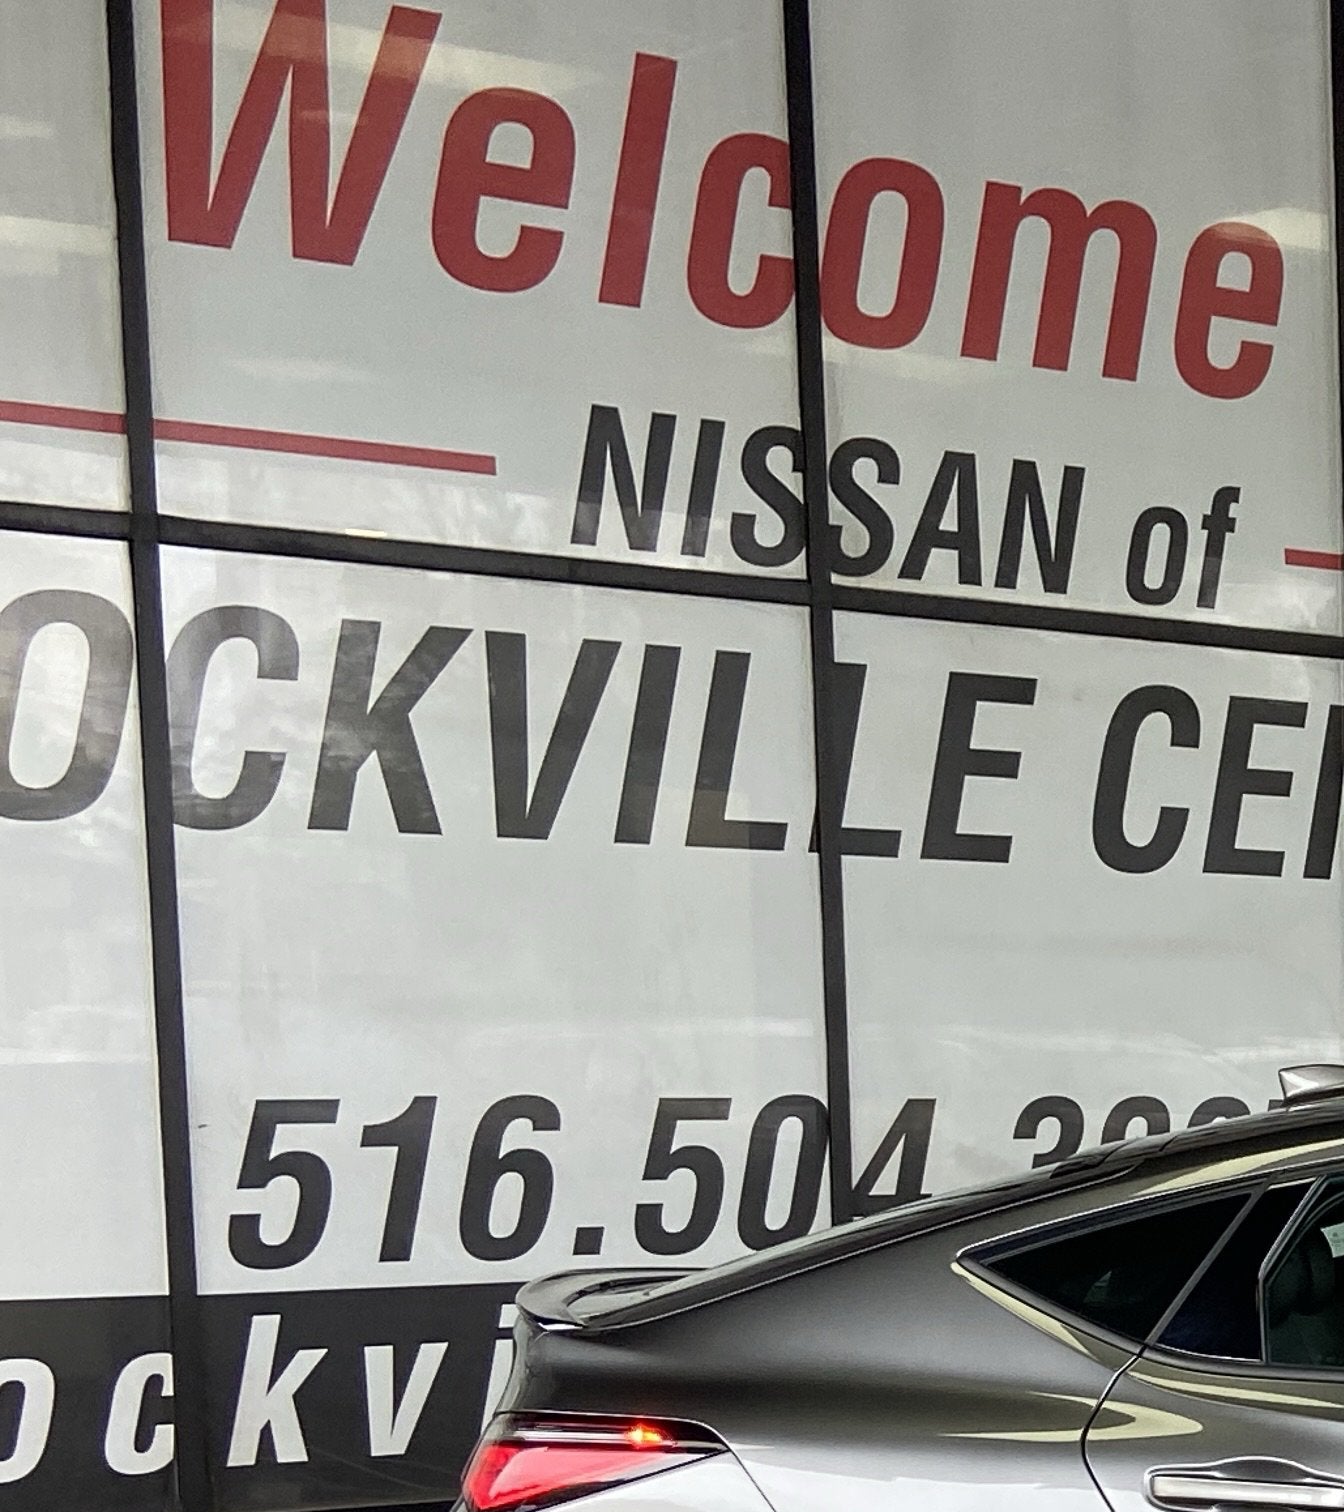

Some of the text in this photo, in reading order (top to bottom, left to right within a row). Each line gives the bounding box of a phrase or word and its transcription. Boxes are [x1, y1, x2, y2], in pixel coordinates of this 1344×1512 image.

[159, 0, 1285, 400] Welcome
[569, 403, 1241, 610] NISSAN of
[0, 588, 1038, 864] OCKVILLE
